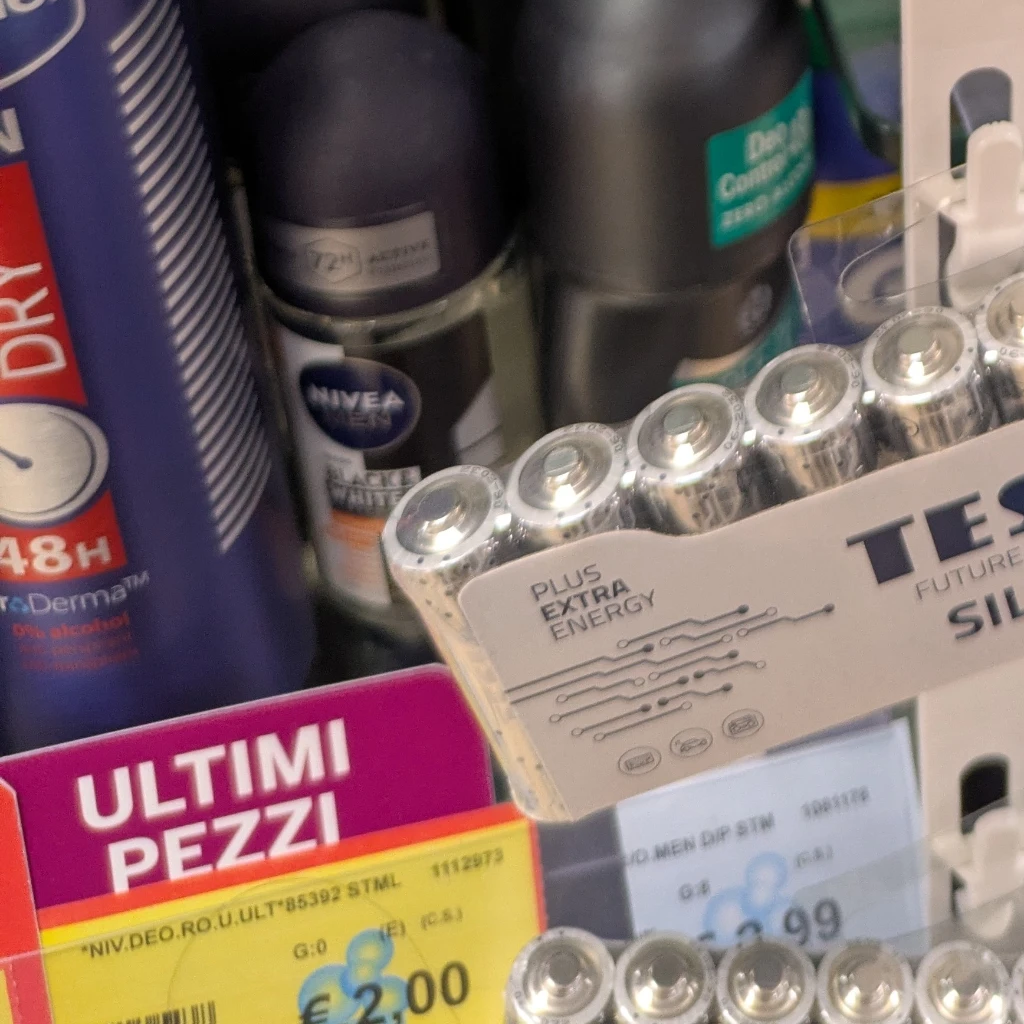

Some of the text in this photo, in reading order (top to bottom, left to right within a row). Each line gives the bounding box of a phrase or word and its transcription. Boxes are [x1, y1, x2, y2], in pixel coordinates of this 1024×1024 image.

[307, 384, 405, 413] NIVEA
[529, 564, 601, 602] PLUS
[914, 546, 1023, 602] FUTURE
[539, 578, 631, 621] EXTRA
[549, 589, 656, 641] ENERGY
[77, 717, 351, 832] ULTIMI
[107, 791, 341, 895] PEZZI
[346, 873, 402, 901] STML
